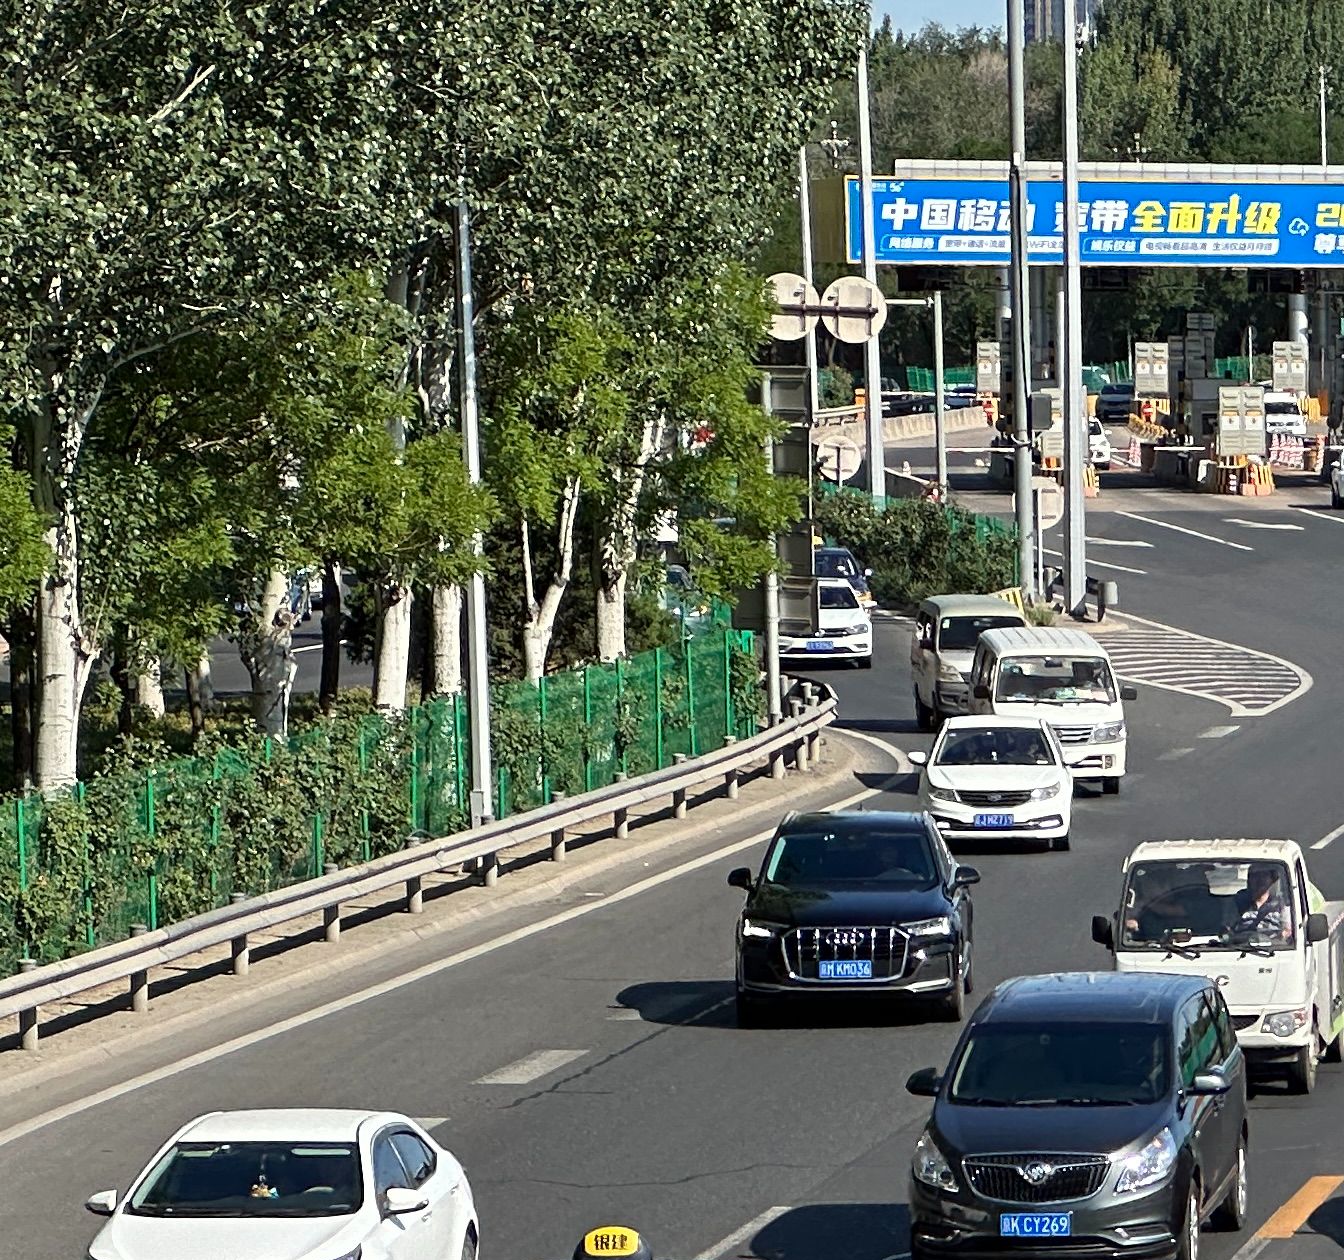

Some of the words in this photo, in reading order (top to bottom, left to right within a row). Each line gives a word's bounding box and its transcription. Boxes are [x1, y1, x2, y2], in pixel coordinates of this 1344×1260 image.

[881, 198, 1036, 232] 中国移动
[1054, 193, 1281, 235] 宽带全面升级
[594, 1233, 628, 1251] 银建
